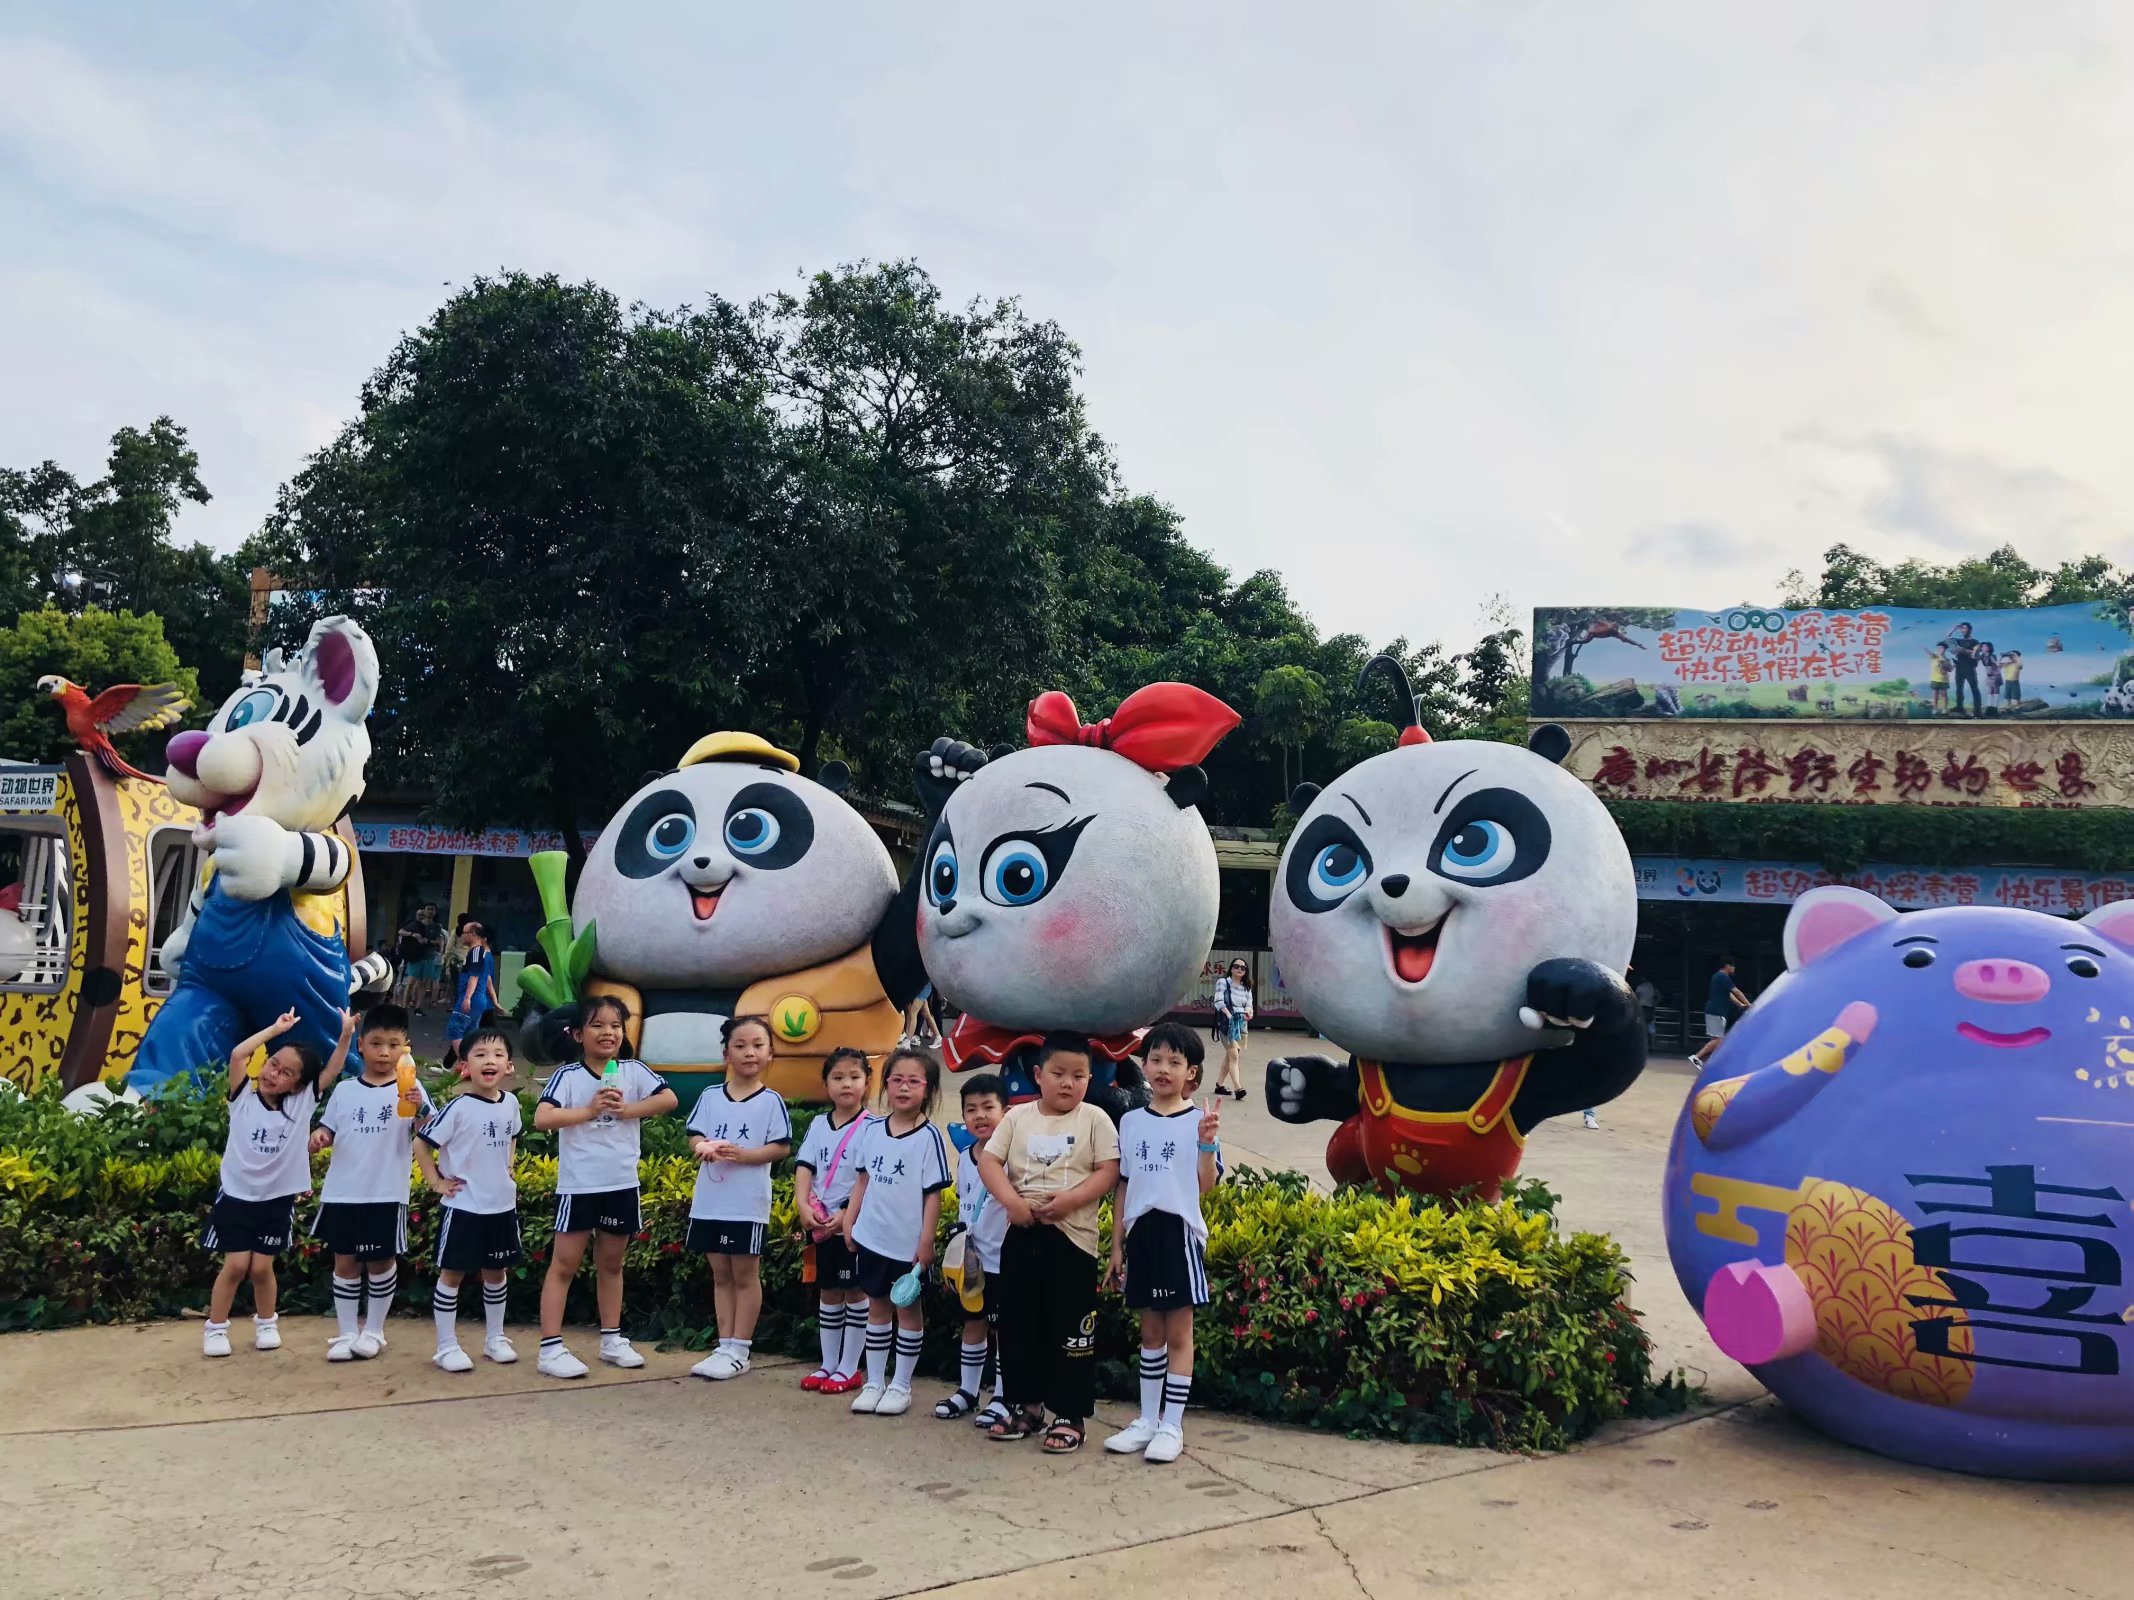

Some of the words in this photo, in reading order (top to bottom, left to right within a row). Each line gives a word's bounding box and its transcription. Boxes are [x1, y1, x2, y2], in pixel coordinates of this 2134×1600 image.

[1658, 612, 1890, 662] 超级动物探索营
[1675, 649, 1883, 683] 快乐暑假在长隆
[1, 777, 55, 795] 动物世界
[0, 796, 29, 805] SAFARI
[31, 796, 52, 805] PARK
[1996, 876, 2134, 910] 快乐暑假
[715, 1123, 749, 1140] 北大
[1136, 1140, 1176, 1162] 清華
[872, 1155, 905, 1176] 北大
[1904, 1164, 2127, 1376] 喜
